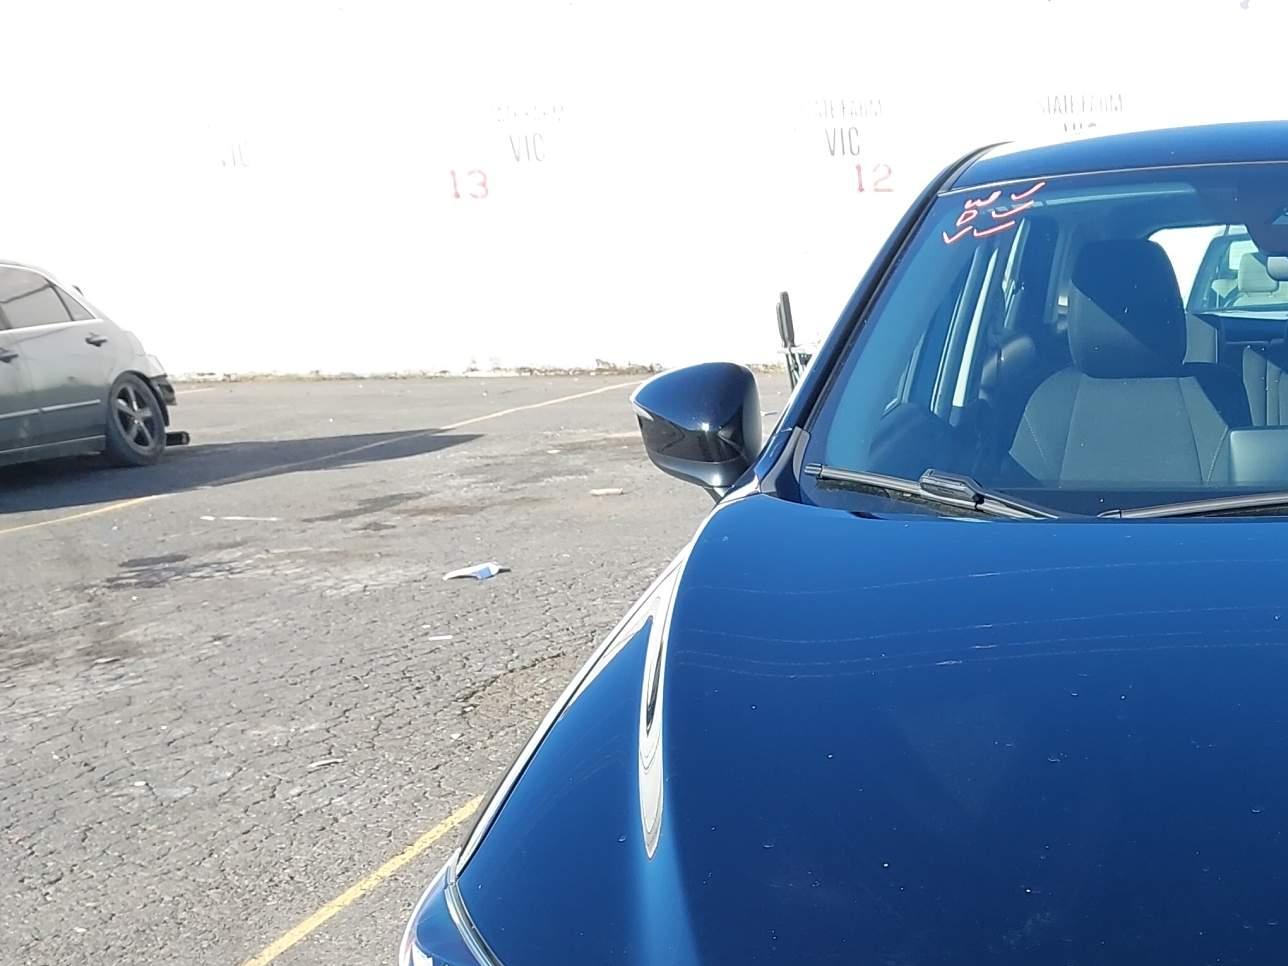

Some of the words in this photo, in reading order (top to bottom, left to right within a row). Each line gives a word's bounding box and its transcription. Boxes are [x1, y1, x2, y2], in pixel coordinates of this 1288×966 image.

[508, 132, 545, 163] VIC
[824, 126, 861, 157] VIC
[450, 168, 489, 200] 13
[855, 163, 895, 193] 12
